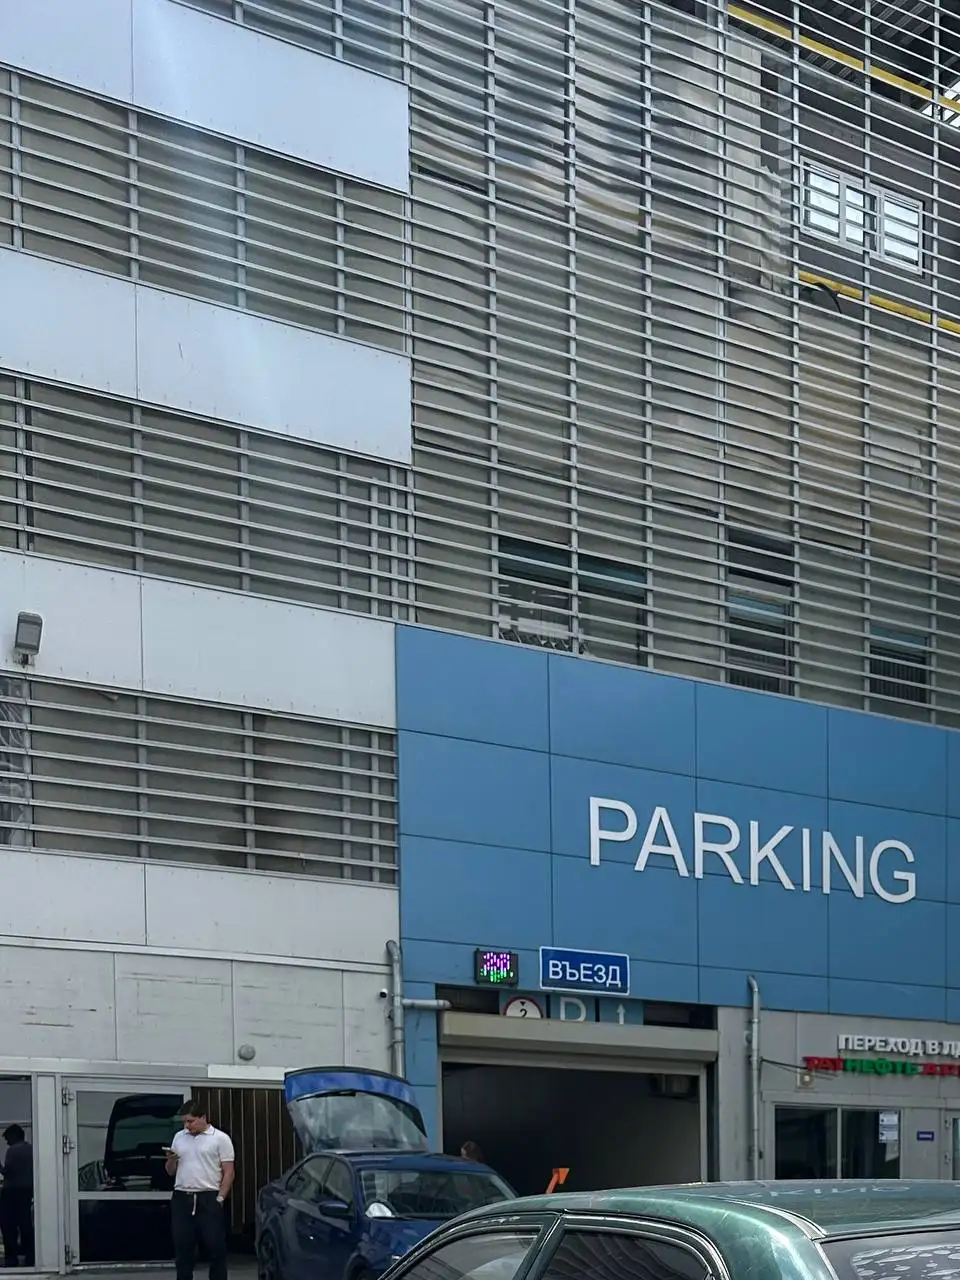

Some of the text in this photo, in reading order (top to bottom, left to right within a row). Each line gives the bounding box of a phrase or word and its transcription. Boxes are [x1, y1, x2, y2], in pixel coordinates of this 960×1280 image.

[589, 796, 917, 904] PARKING
[548, 960, 621, 988] ВЪЕЗД
[838, 1034, 925, 1057] ПЕРЕХОД
[925, 1039, 940, 1055] В
